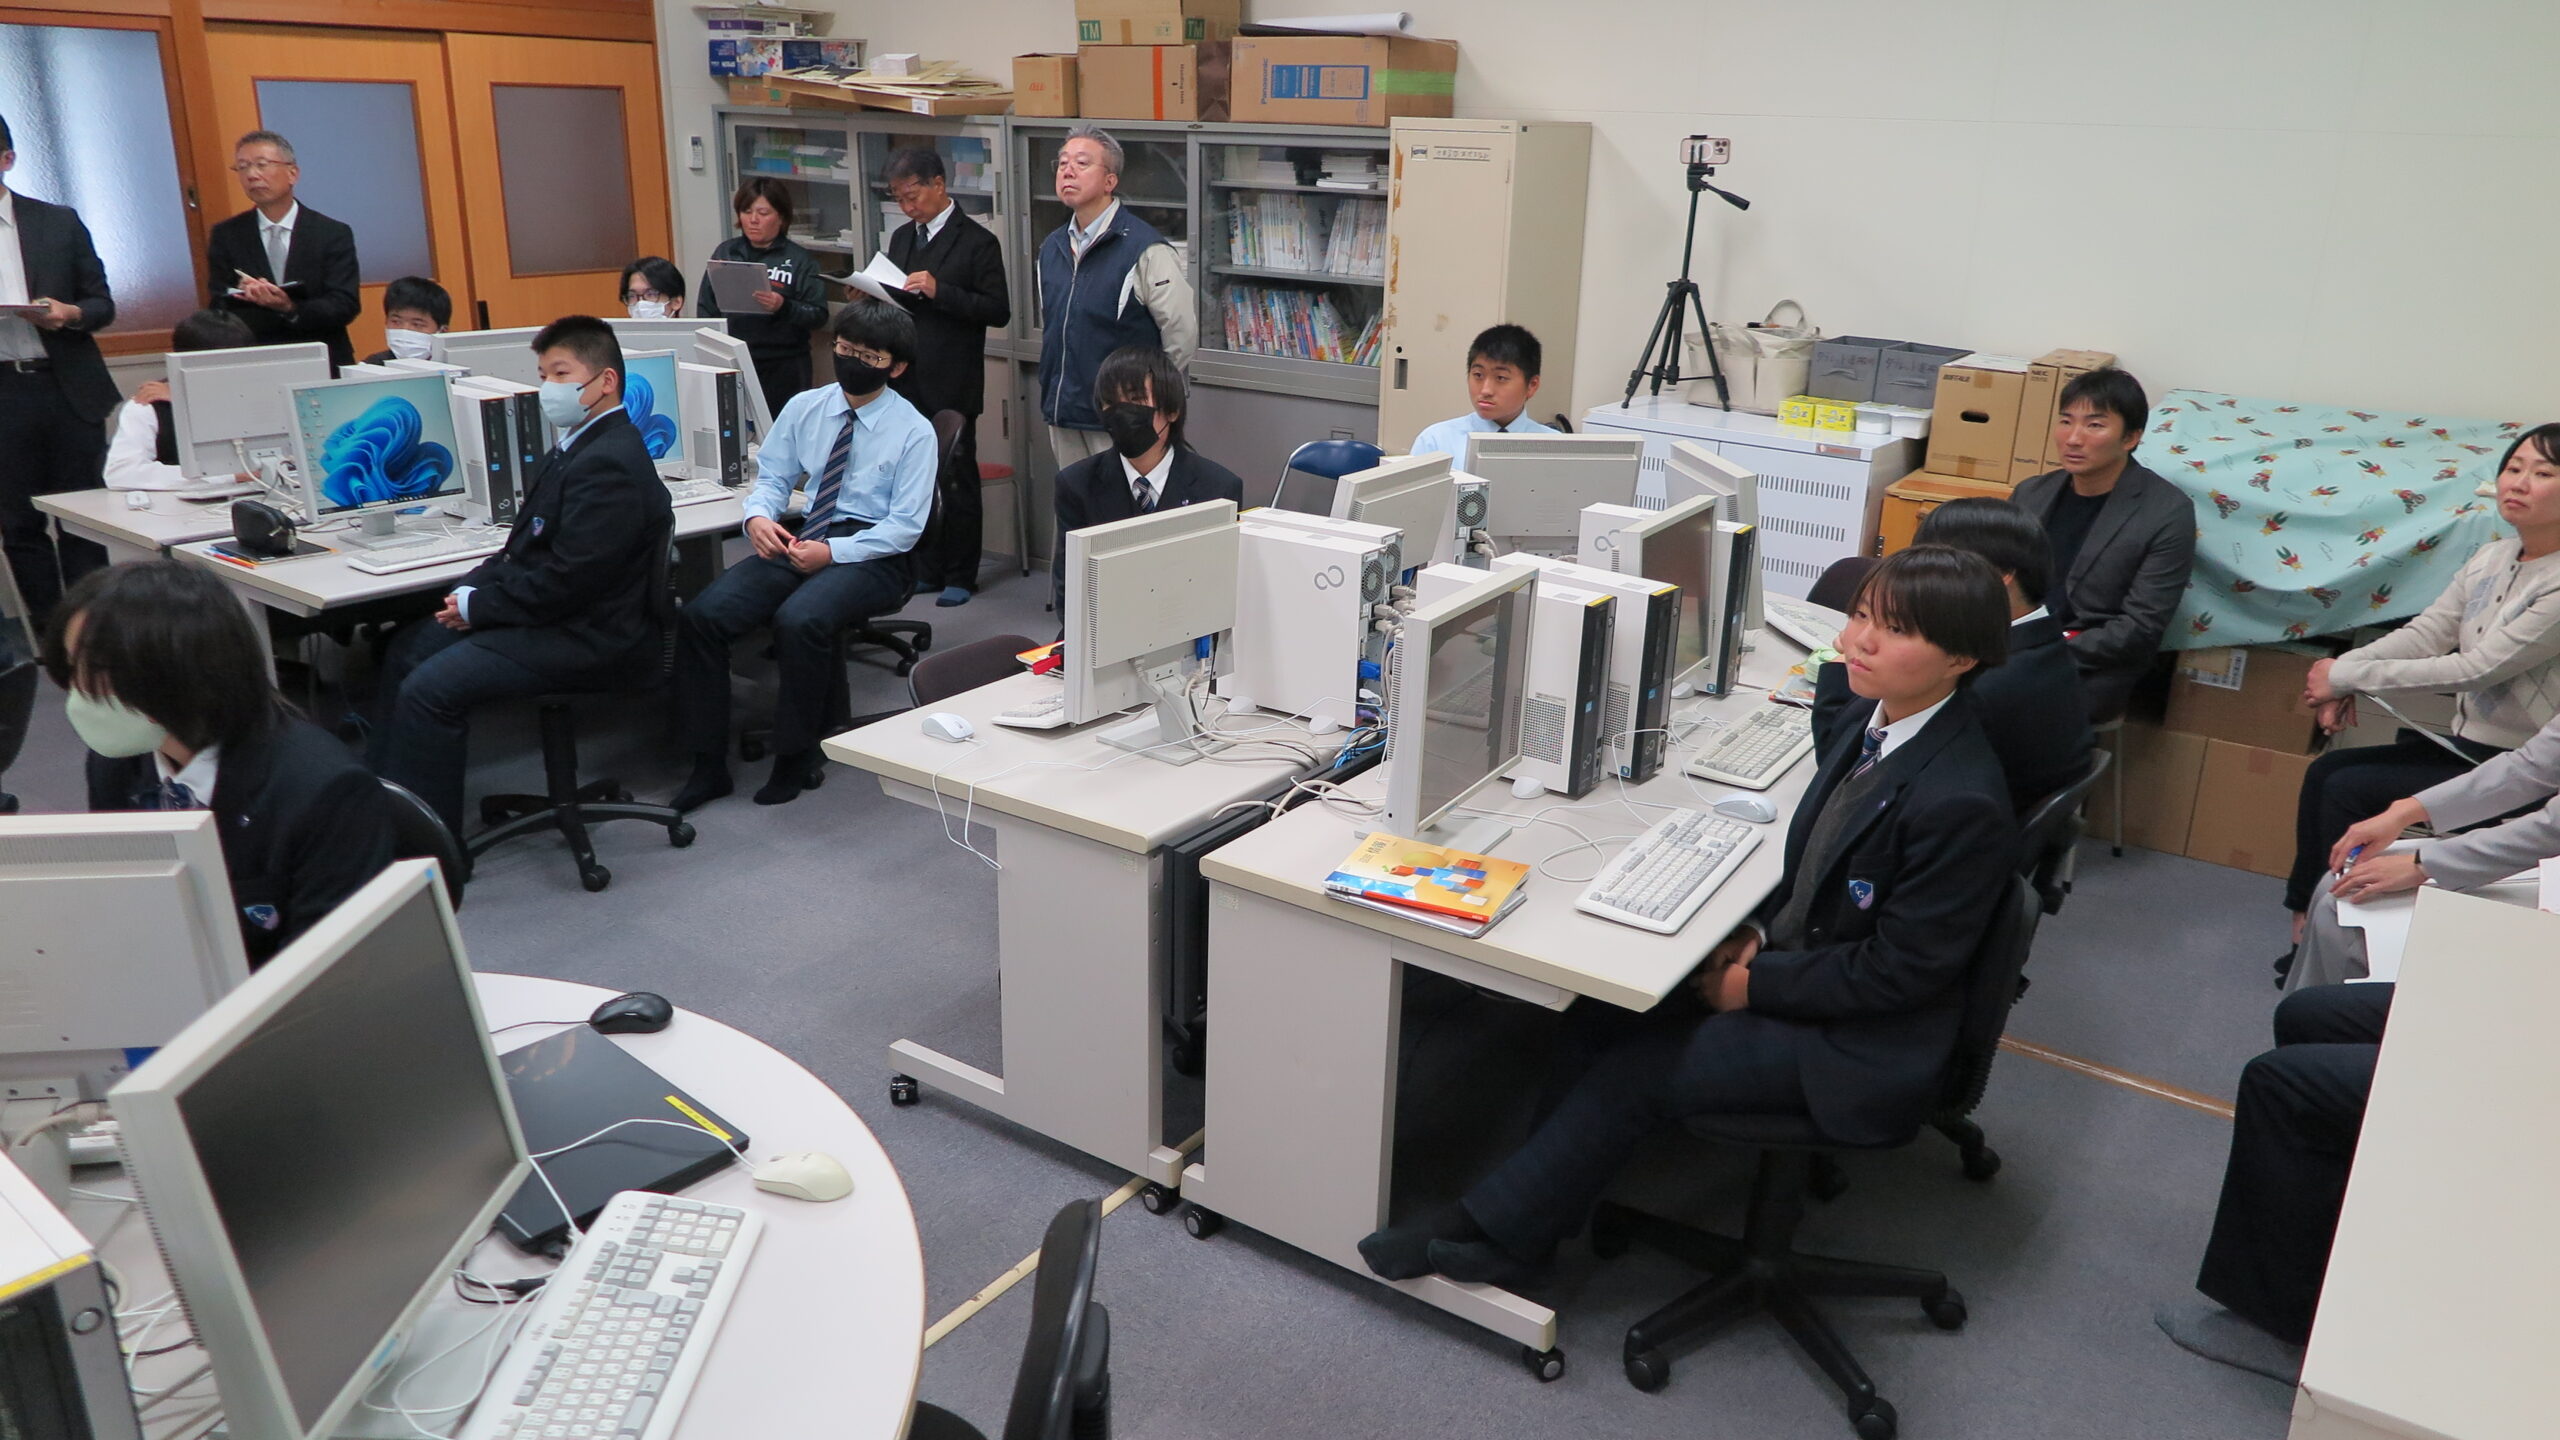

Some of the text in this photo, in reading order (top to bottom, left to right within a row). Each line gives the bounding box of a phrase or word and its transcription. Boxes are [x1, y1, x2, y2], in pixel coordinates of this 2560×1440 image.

[1081, 22, 1100, 40] TM
[1188, 20, 1203, 38] TM
[1260, 57, 1269, 105] Panasonic
